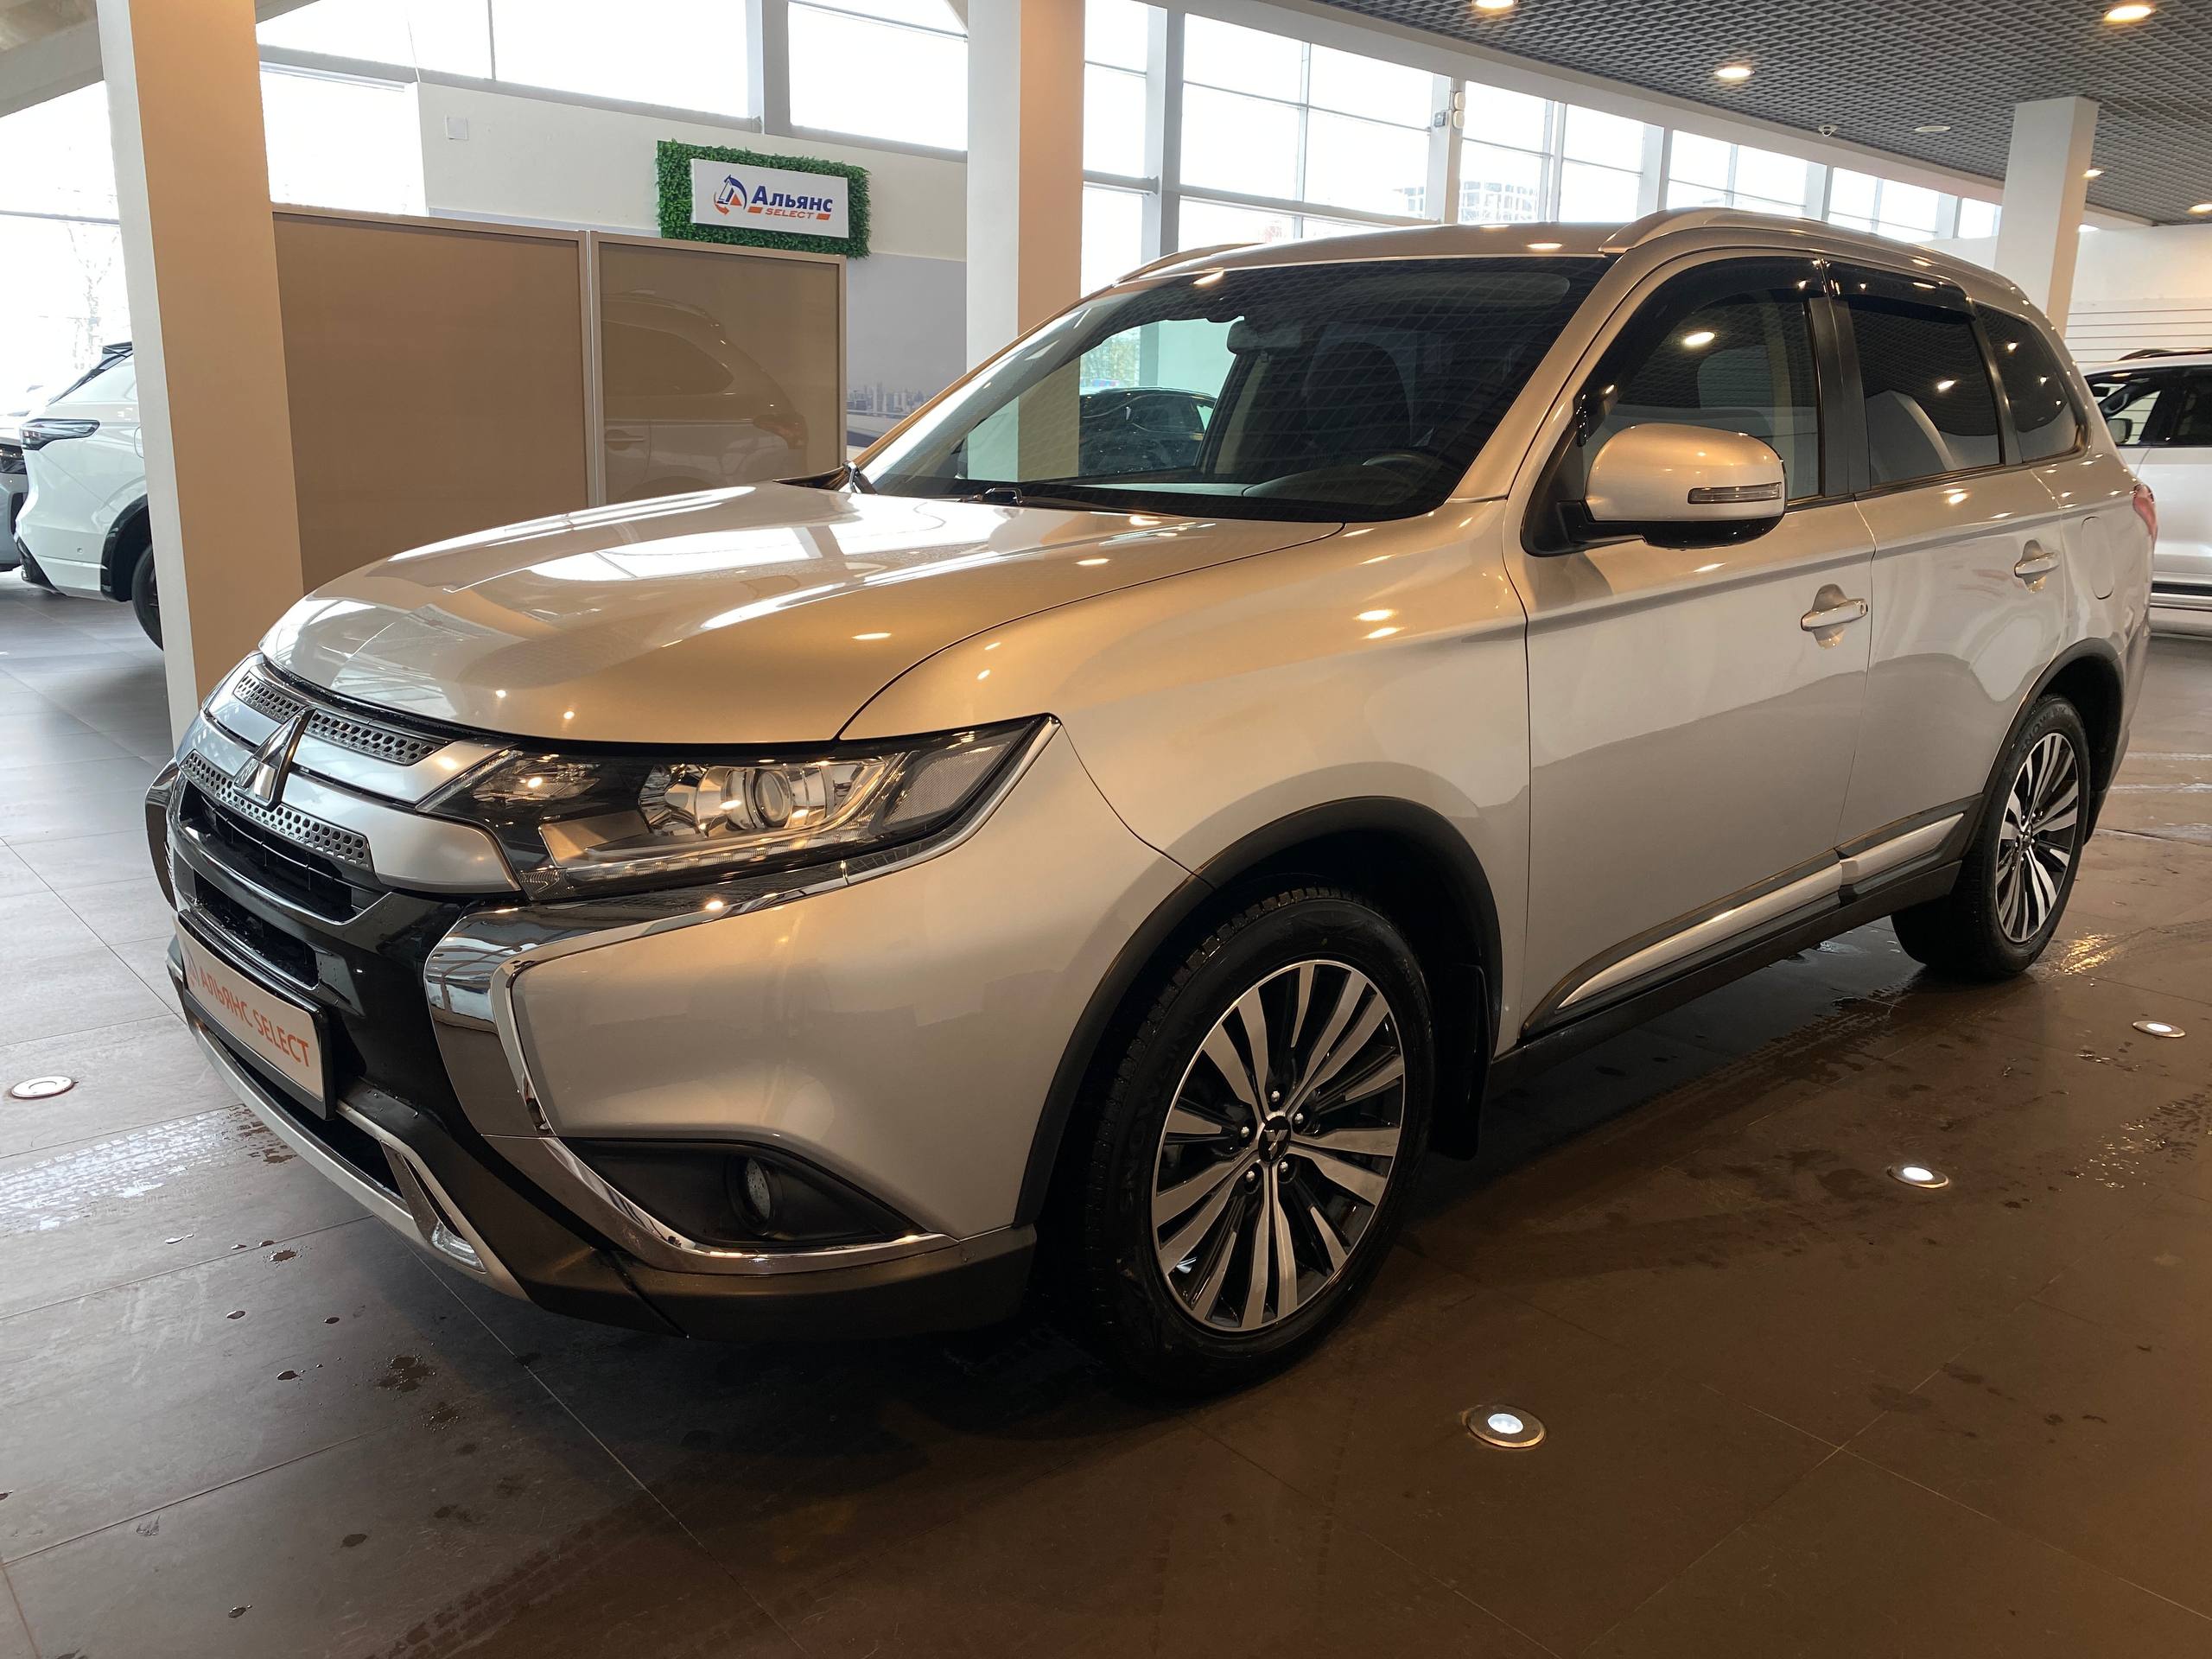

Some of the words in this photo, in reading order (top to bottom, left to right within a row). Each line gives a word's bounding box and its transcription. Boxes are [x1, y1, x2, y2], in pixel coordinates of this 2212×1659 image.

[751, 185, 833, 213] Альянс
[765, 207, 815, 219] SELECT
[200, 966, 253, 1027] АЛЬЯНС
[252, 1008, 309, 1067] SELECT
